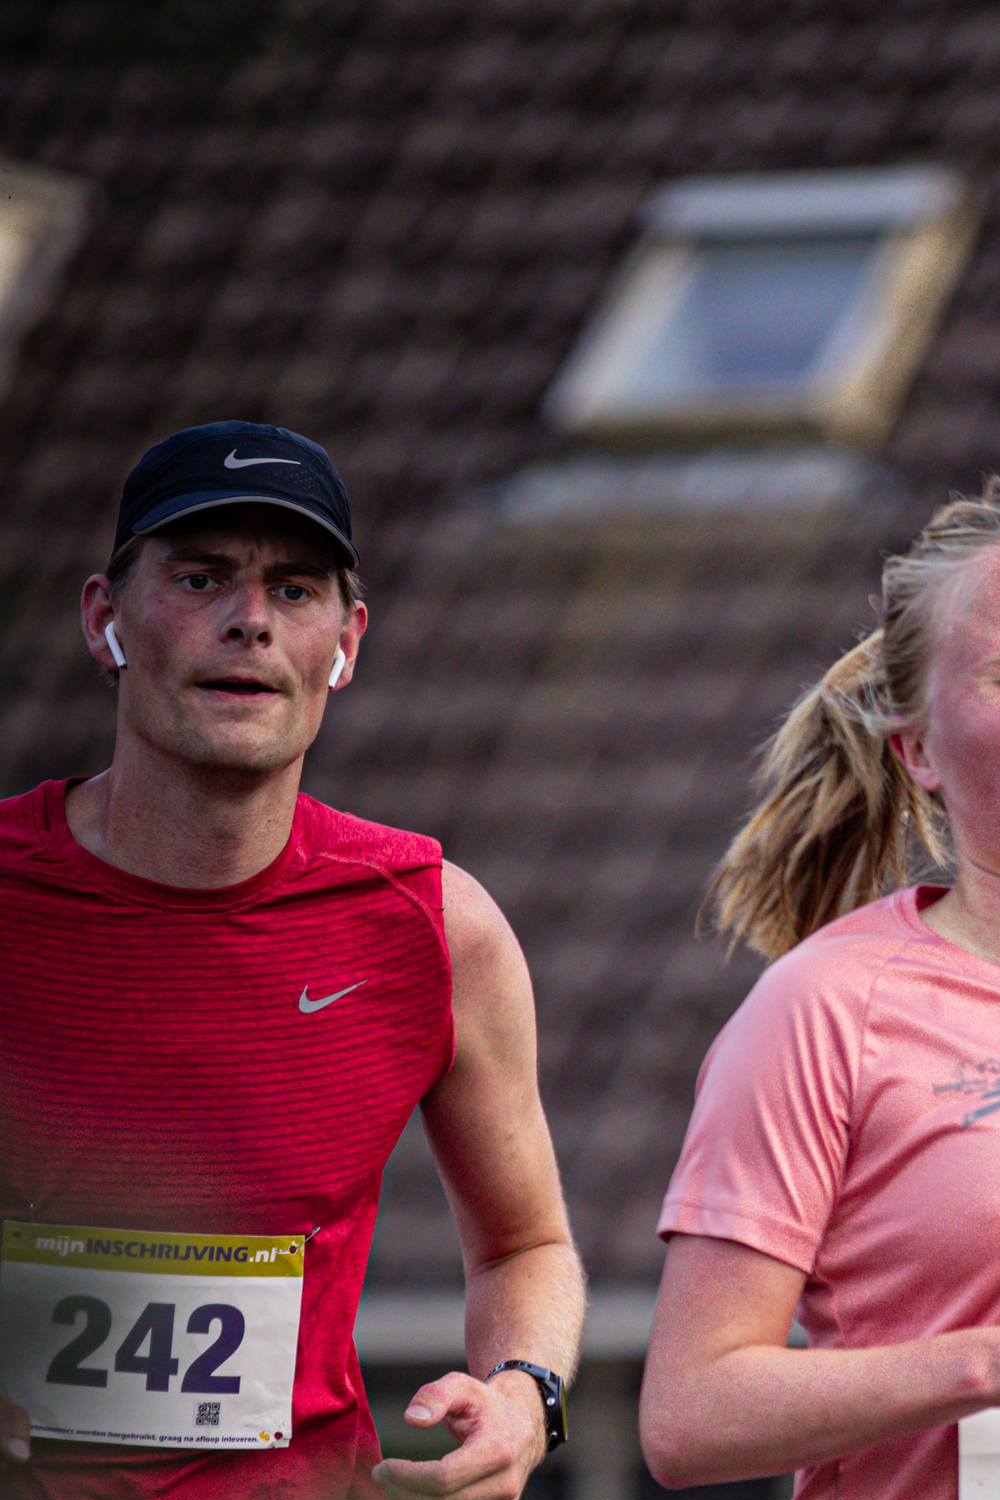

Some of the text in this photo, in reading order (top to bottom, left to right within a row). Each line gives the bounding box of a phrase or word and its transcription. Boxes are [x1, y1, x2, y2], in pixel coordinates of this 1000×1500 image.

[35, 1235, 276, 1263] mijnINSCHRIJVING.nl
[46, 1295, 246, 1395] 242
[31, 1424, 75, 1435] rtnummers
[76, 1429, 106, 1438] worden
[108, 1431, 157, 1442] hergebruikt,
[159, 1434, 182, 1444] graag
[196, 1435, 220, 1445] afloop
[221, 1435, 260, 1444] inleveren.
